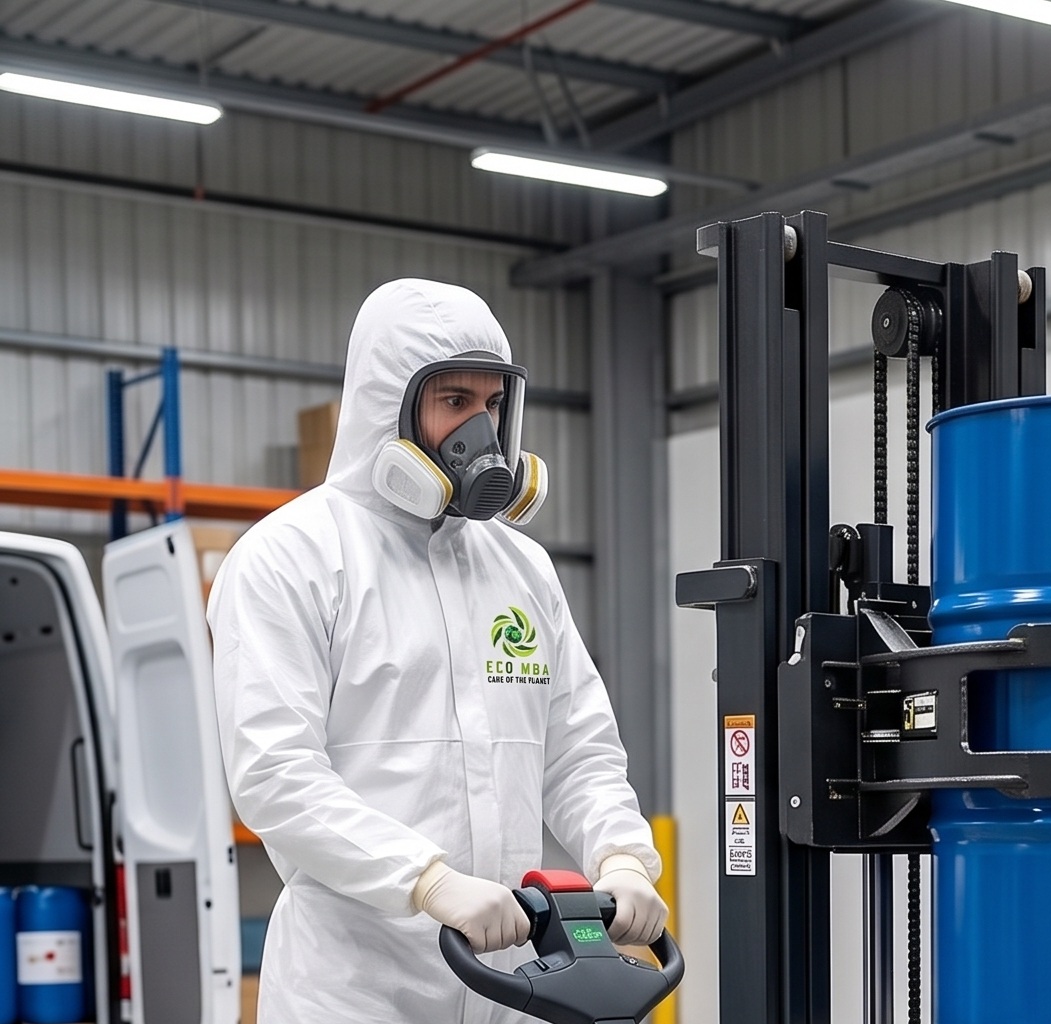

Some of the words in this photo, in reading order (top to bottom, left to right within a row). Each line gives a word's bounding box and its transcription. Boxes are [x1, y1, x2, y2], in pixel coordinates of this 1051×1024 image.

[486, 661, 513, 674] ECO
[521, 662, 549, 676] MBA
[505, 676, 514, 684] OF
[515, 676, 527, 684] THE
